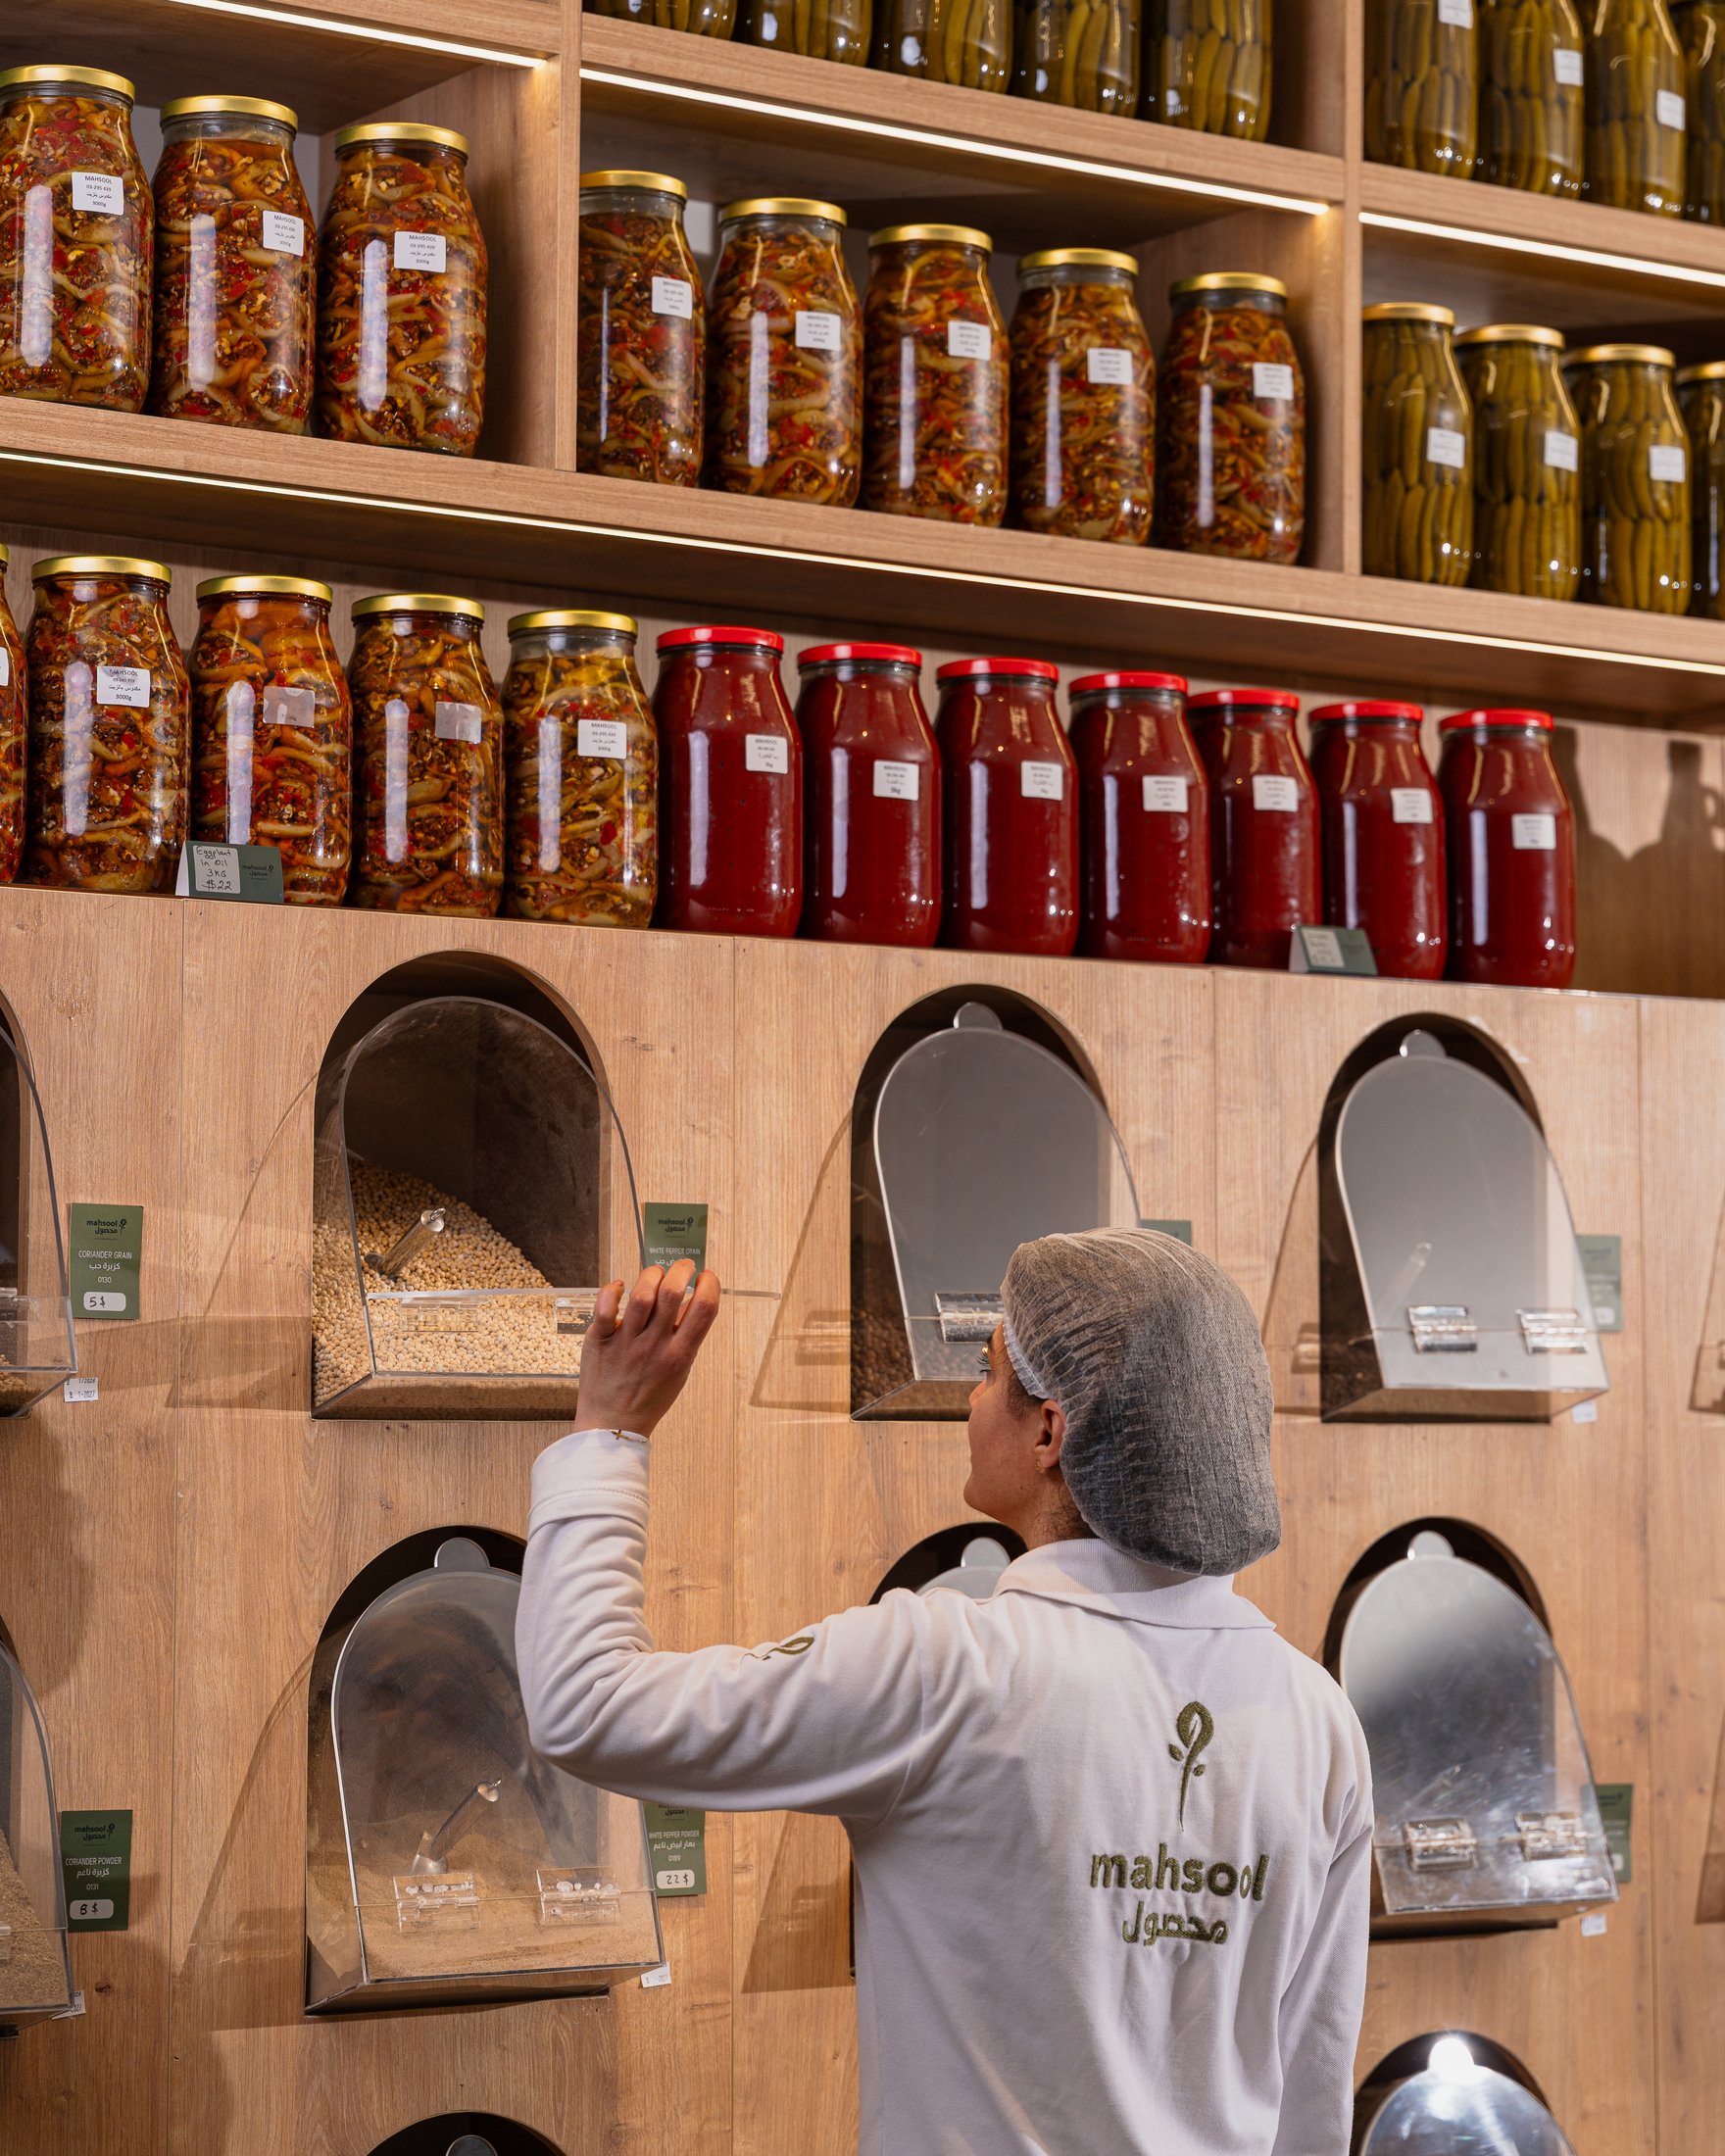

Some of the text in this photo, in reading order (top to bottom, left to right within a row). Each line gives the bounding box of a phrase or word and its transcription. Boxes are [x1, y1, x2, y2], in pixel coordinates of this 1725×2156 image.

[84, 175, 112, 184] MAHSOOL
[196, 846, 231, 859] Eggplant
[86, 1218, 118, 1227] mahsool
[78, 1250, 132, 1260] CORIANDER GRAIN
[665, 1247, 685, 1255] PEPPER
[103, 1261, 121, 1271] كزبرة
[74, 1824, 106, 1834] mahsool
[680, 1830, 700, 1838] POWDER
[653, 1840, 666, 1851] ناعم
[65, 1856, 123, 1866] CORIANDER POWDER
[76, 1867, 110, 1879] كزبرة ناعم
[1089, 1840, 1270, 1902] mahsool
[1122, 1900, 1231, 1946] محصول
